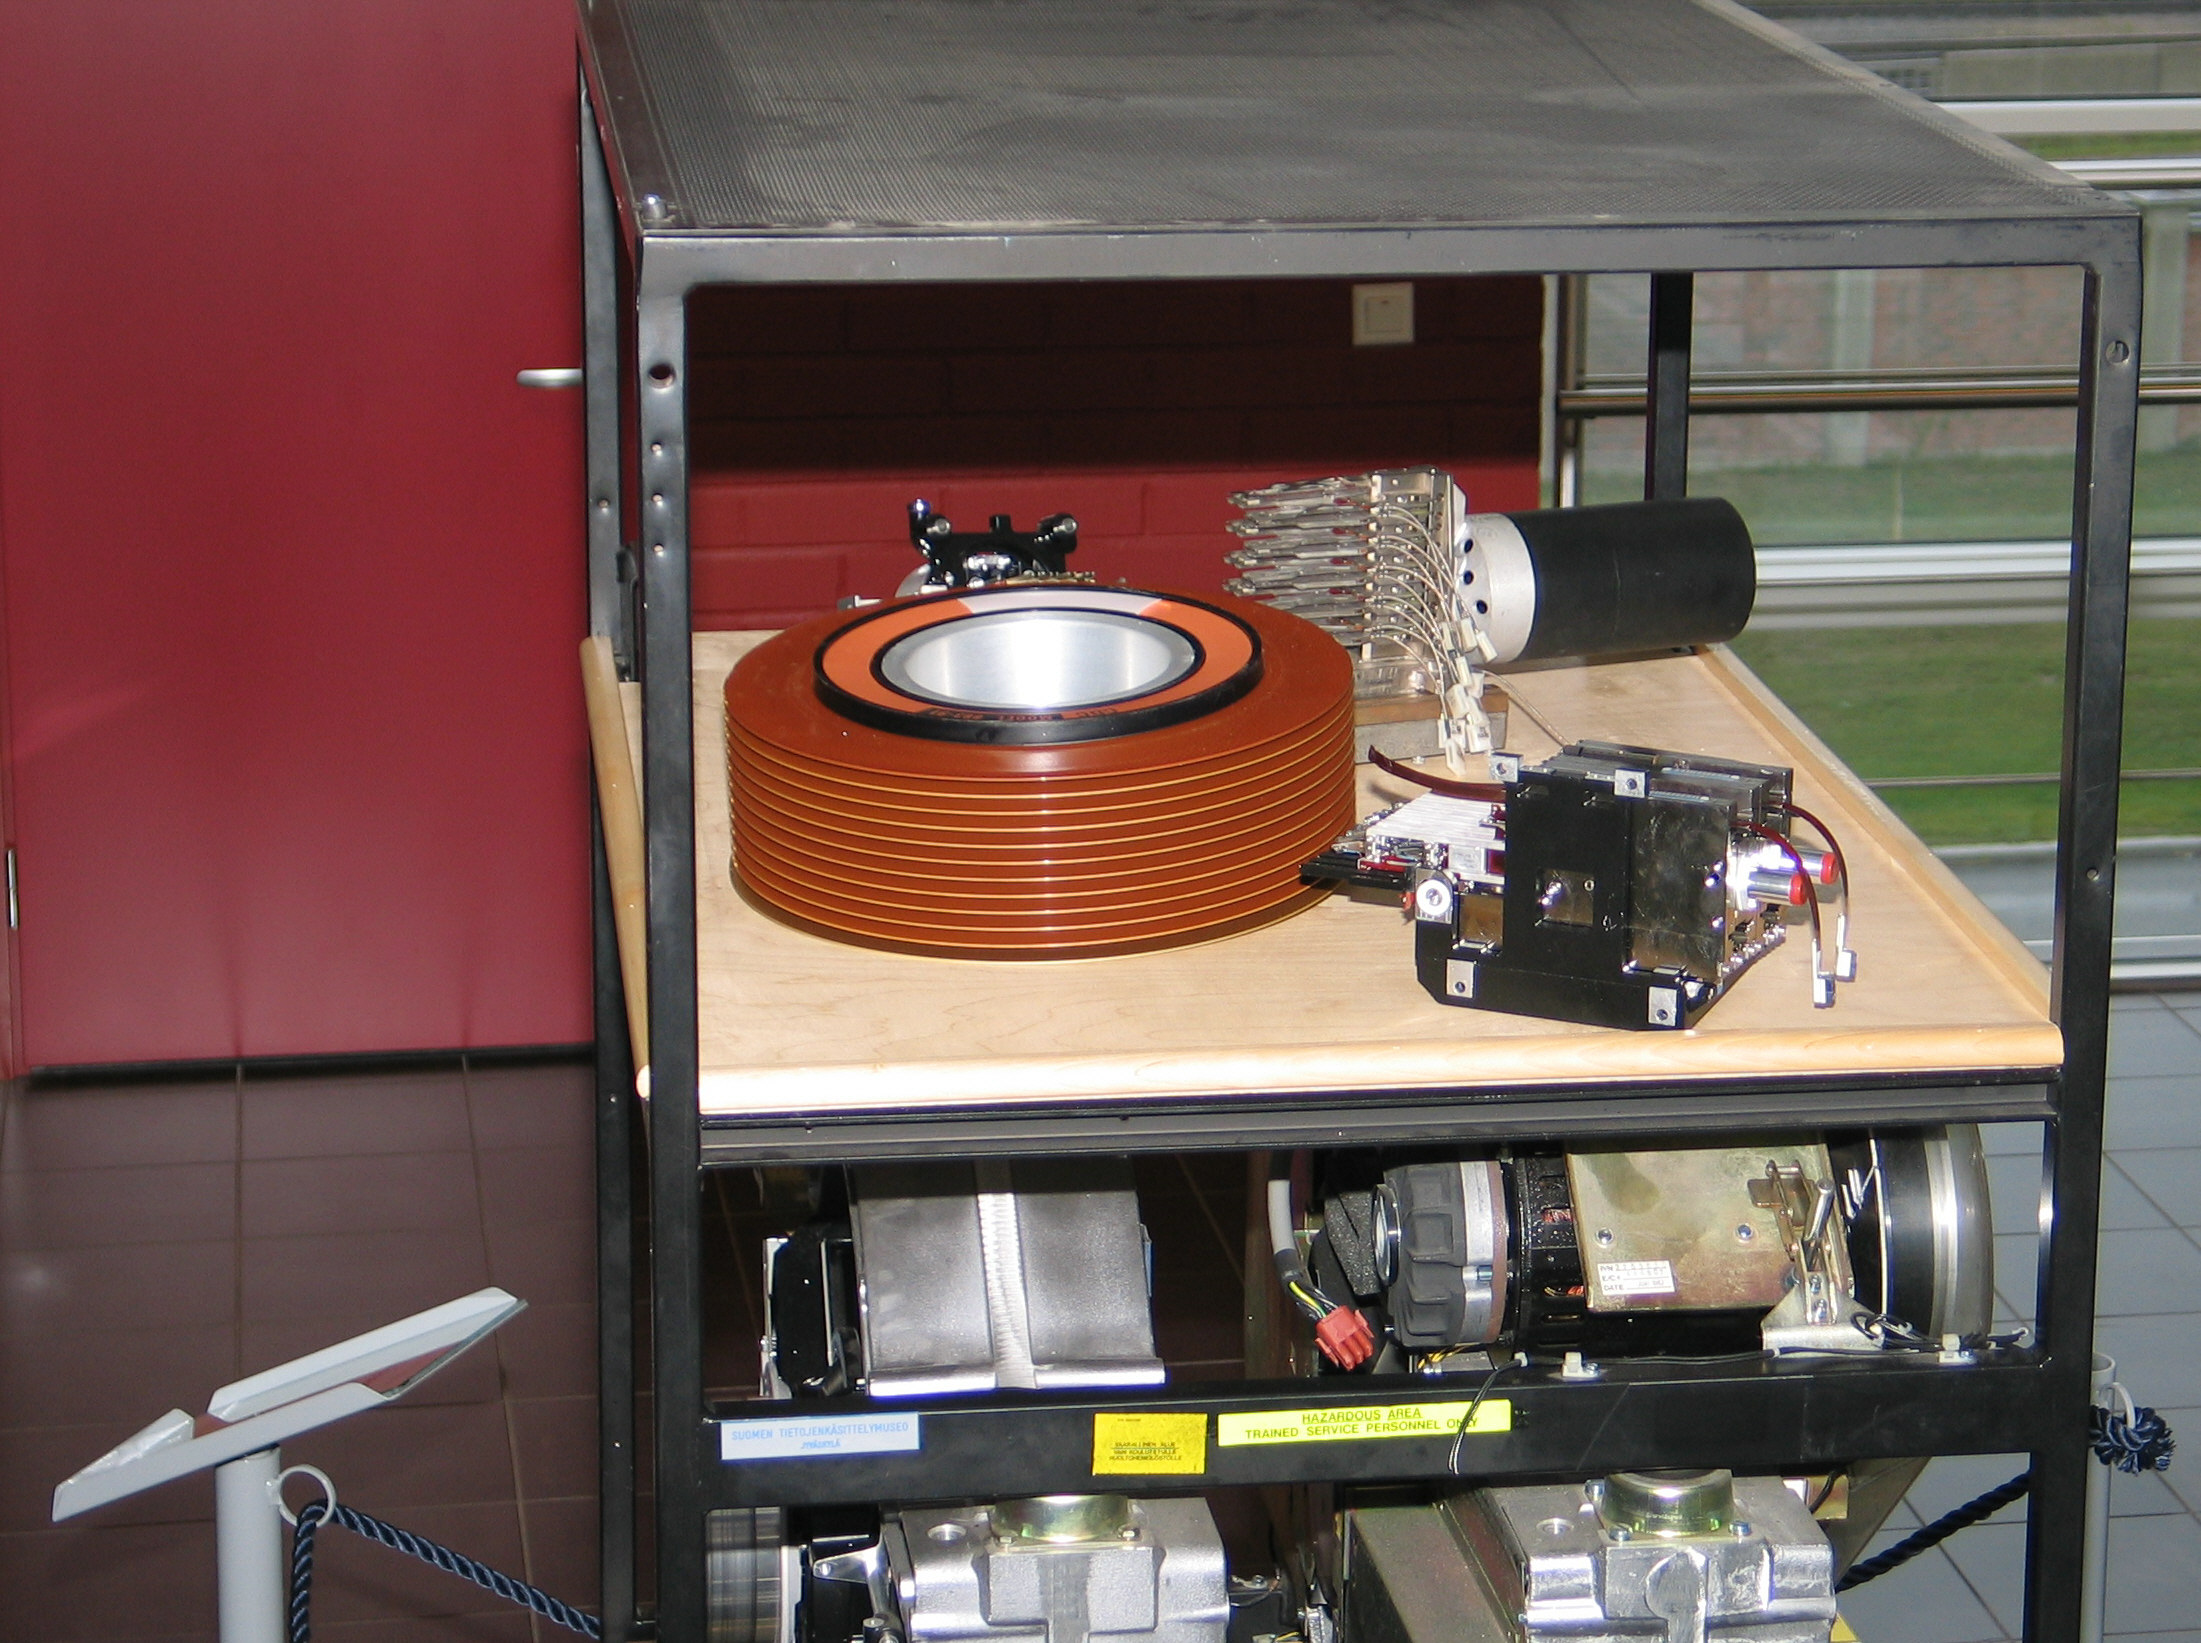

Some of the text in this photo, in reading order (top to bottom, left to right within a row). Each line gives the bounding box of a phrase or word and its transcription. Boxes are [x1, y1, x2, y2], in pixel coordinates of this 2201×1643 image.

[1302, 1407, 1421, 1424] HAZARDOUS AREA
[731, 1421, 909, 1441] SUOMEN TIETOJENKÄSITTELYMUSEO
[1245, 1427, 1299, 1439] TRAINED
[1306, 1424, 1359, 1436] SERVICE
[1366, 1419, 1441, 1432] PERSONNEL
